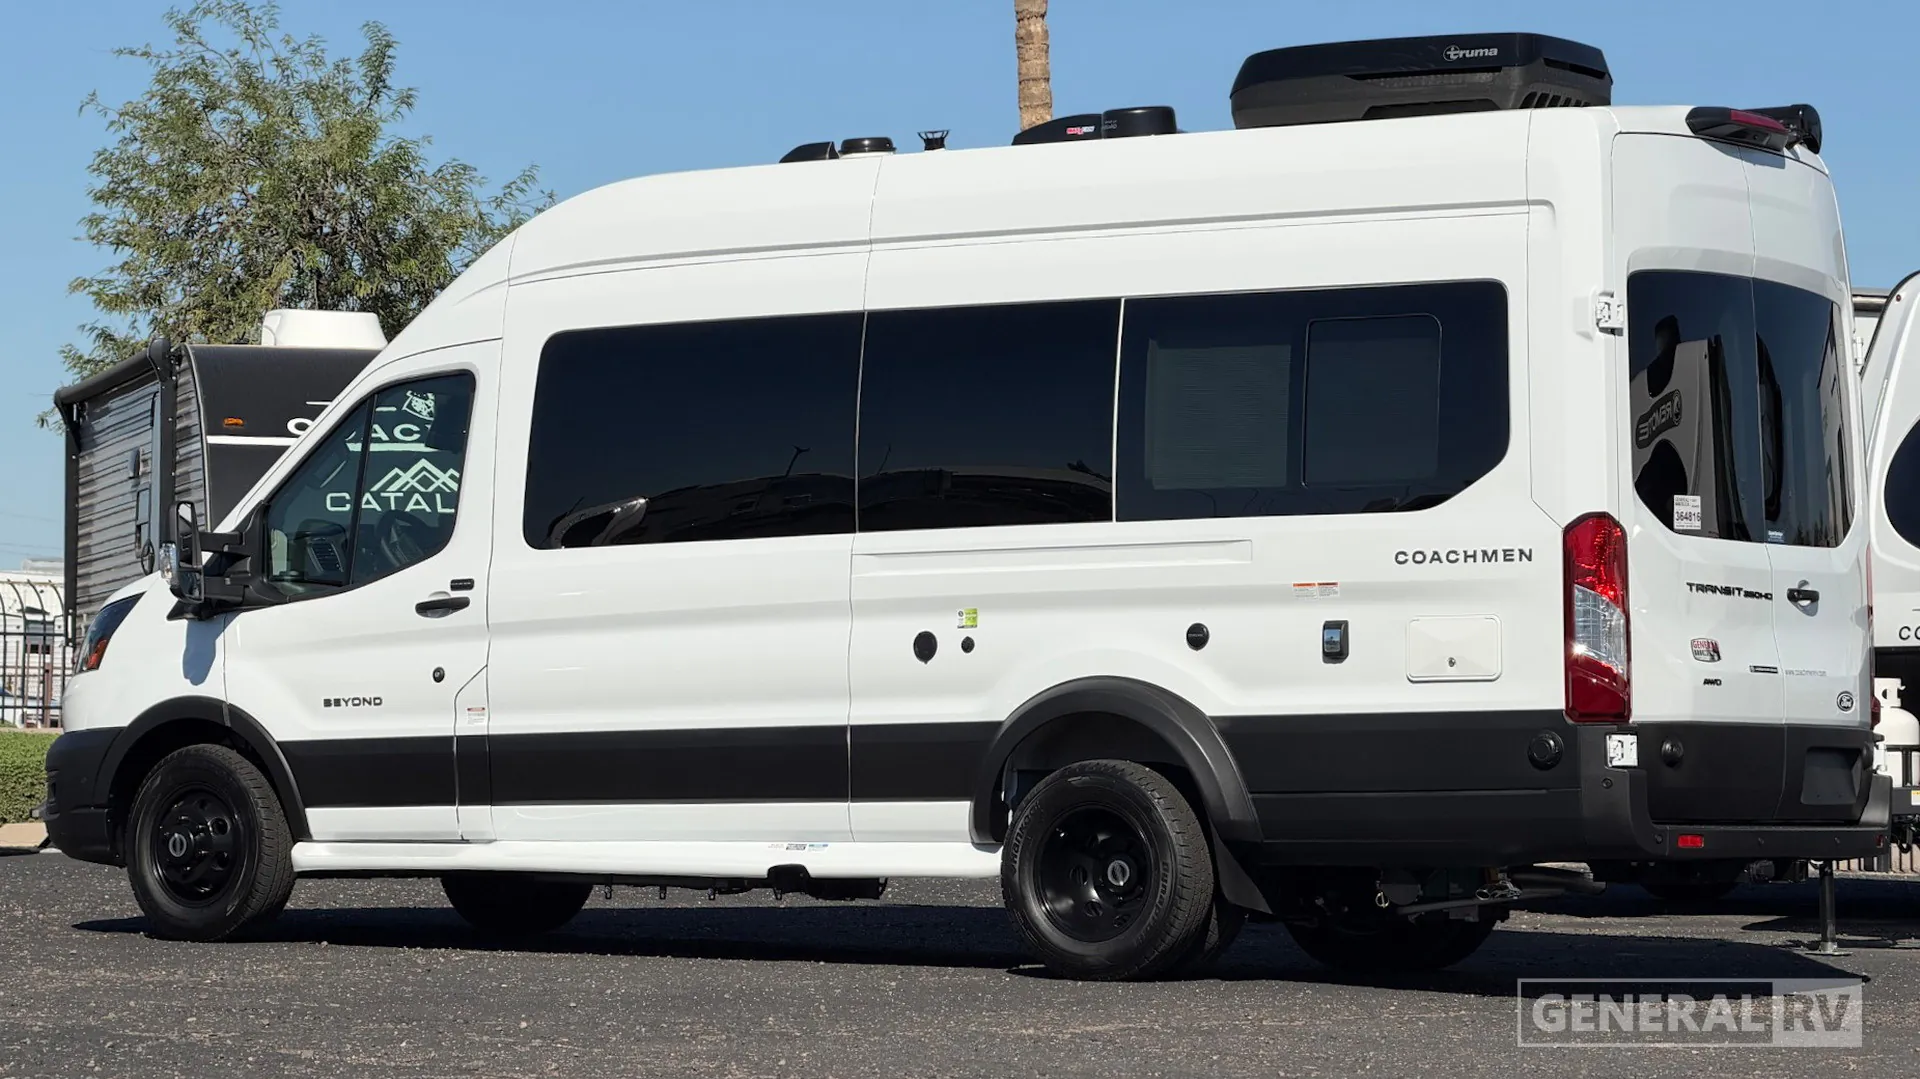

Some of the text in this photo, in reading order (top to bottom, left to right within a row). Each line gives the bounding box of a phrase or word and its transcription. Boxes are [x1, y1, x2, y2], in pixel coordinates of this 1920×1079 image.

[1445, 46, 1499, 60] truma
[326, 492, 455, 513] CATAL
[1675, 511, 1702, 522] 364816
[1394, 548, 1532, 565] COACHMEN
[1686, 582, 1743, 597] TRANSIT
[323, 697, 383, 708] BEYOND
